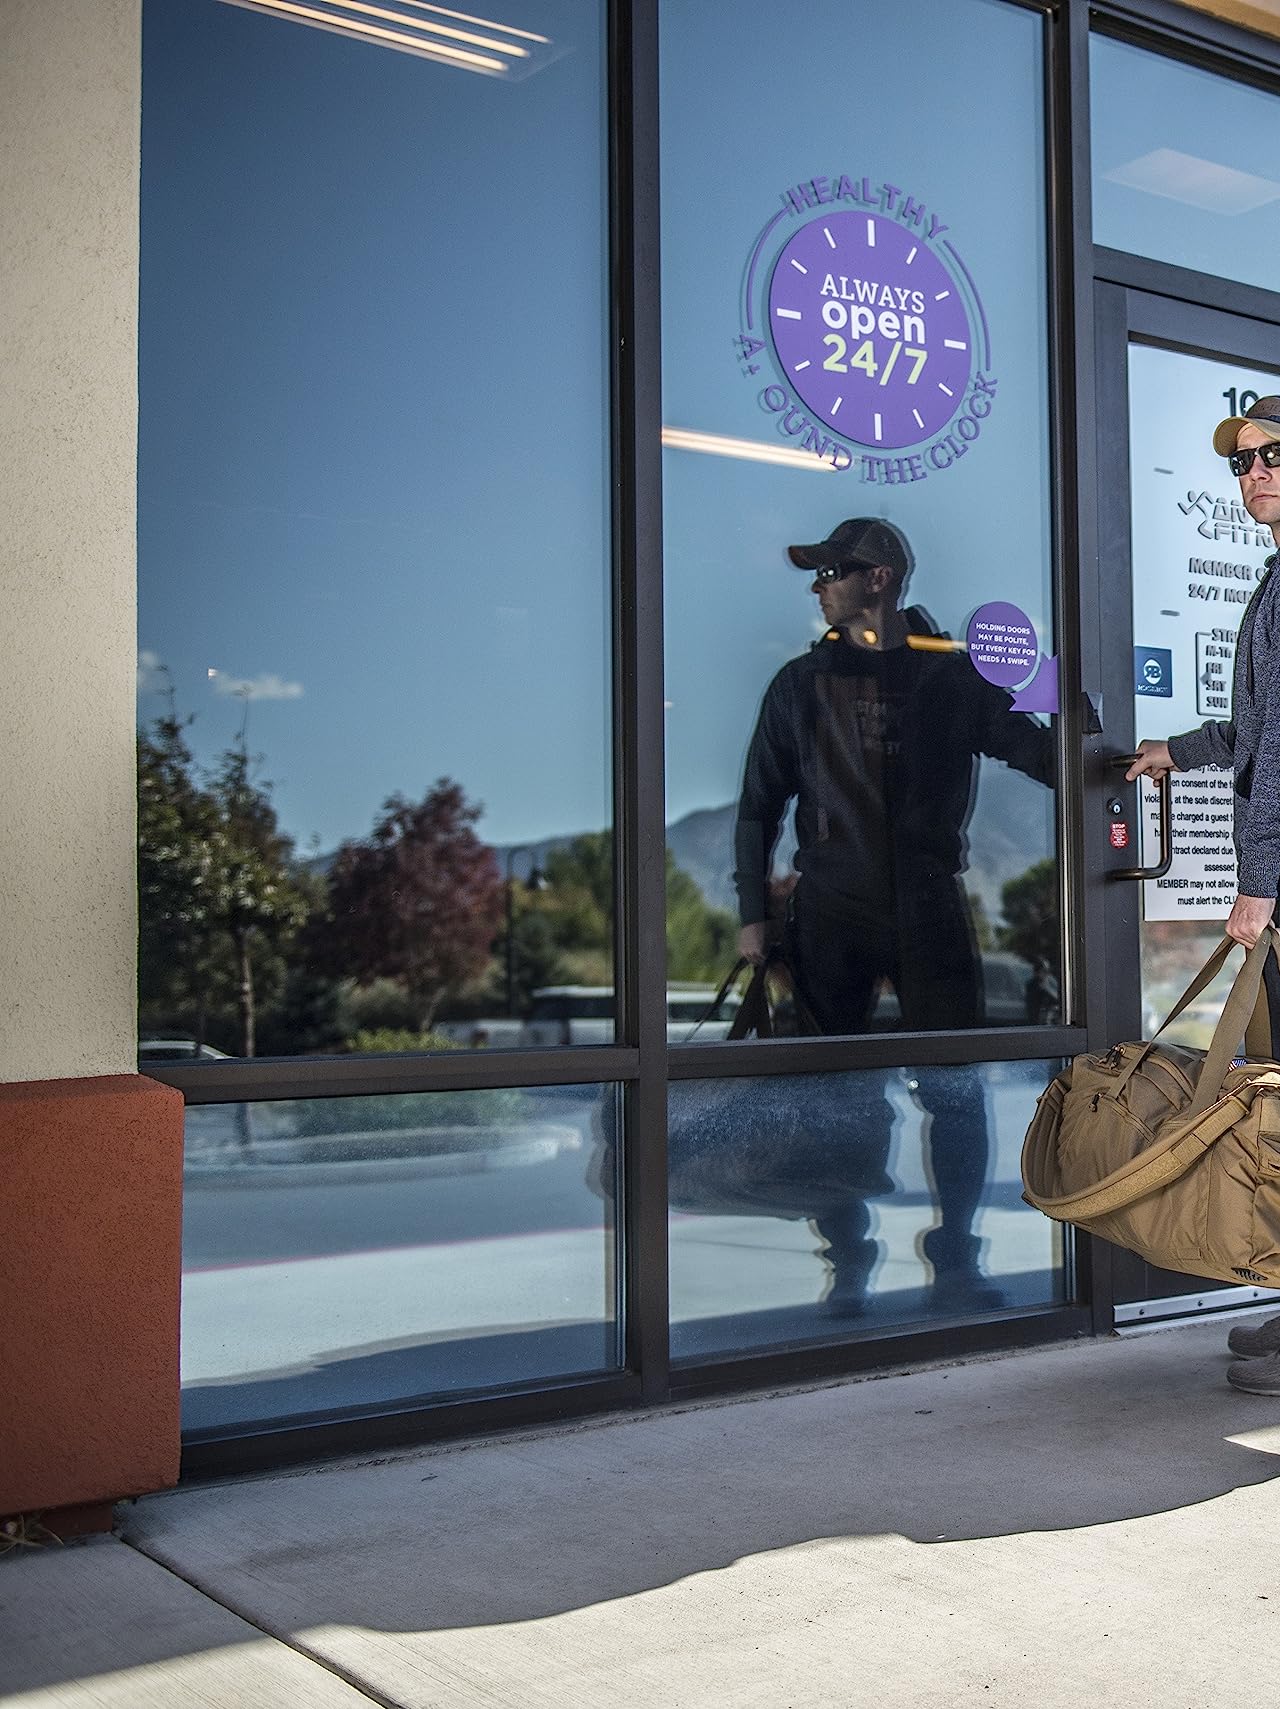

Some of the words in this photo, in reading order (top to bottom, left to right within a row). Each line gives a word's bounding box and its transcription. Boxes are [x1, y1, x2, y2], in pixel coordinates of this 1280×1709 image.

[786, 175, 948, 239] HEALTHY
[820, 273, 925, 314] ALWAYS
[822, 301, 925, 347] open
[822, 333, 928, 386] 24/7
[739, 333, 852, 471] AOUND
[862, 455, 927, 484] THE
[930, 371, 998, 469] CLOCK
[1188, 557, 1253, 581] MEMBER
[1188, 582, 1221, 602] 24/7
[976, 623, 1006, 632] HOLDING
[1007, 626, 1030, 635] DOORS
[1004, 636, 1029, 646] POLITE,
[986, 645, 1007, 653] EVERY
[1008, 647, 1021, 655] KEY
[1022, 648, 1036, 656] FOB
[978, 655, 999, 663] NEEDS
[1007, 658, 1029, 666] SWIPE.
[1206, 662, 1223, 674] FRI
[1206, 680, 1226, 692] SAT
[1206, 696, 1229, 709] SUN
[1181, 780, 1208, 788] consent
[1209, 780, 1217, 788] of
[1217, 780, 1228, 788] the
[1182, 796, 1194, 804] the
[1194, 796, 1208, 804] sole
[1176, 811, 1204, 823] charged
[1210, 812, 1229, 823] guest
[1172, 829, 1188, 838] their
[1189, 829, 1229, 840] membership
[1191, 846, 1220, 854] declared
[1221, 846, 1233, 855] due
[1204, 863, 1234, 871] assessed
[1157, 880, 1188, 888] MEMBER
[1190, 881, 1204, 890] may
[1217, 880, 1235, 888] allow
[1178, 896, 1195, 905] must
[1196, 896, 1211, 904] alert
[1212, 896, 1222, 904] the
